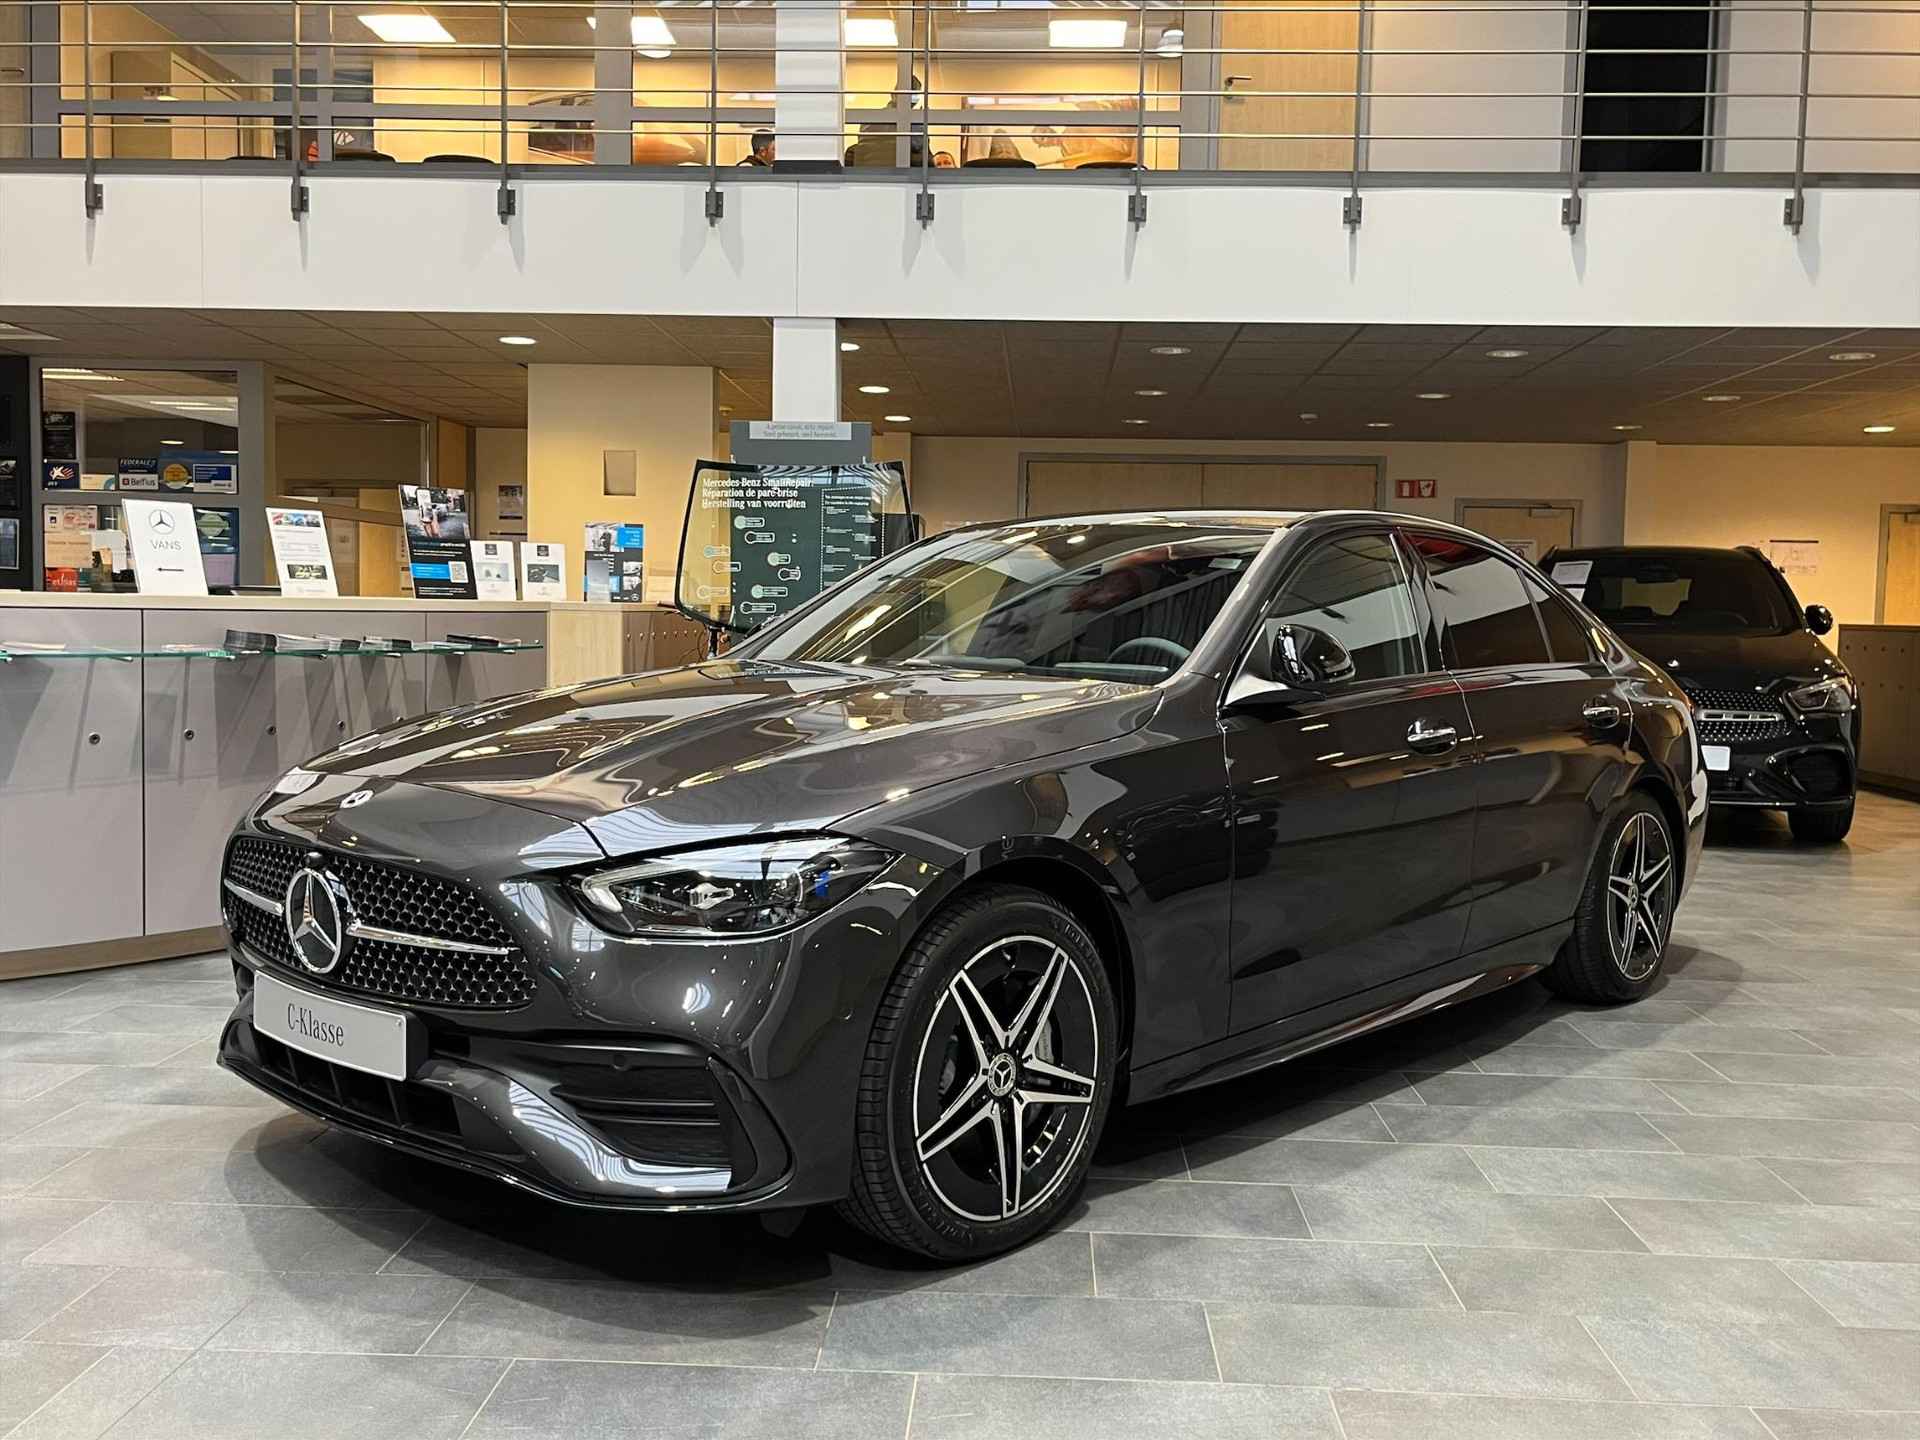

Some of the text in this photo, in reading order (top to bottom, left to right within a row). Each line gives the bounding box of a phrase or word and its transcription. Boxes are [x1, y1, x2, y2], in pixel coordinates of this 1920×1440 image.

[130, 477, 156, 487] Belfius
[703, 477, 761, 487] Mercedes-Benz
[702, 488, 798, 499] Réparation de parc-brise
[702, 499, 745, 510] Herstelling
[747, 500, 761, 508] van
[150, 539, 182, 551] VANS
[287, 1003, 345, 1047] C-Klasse
